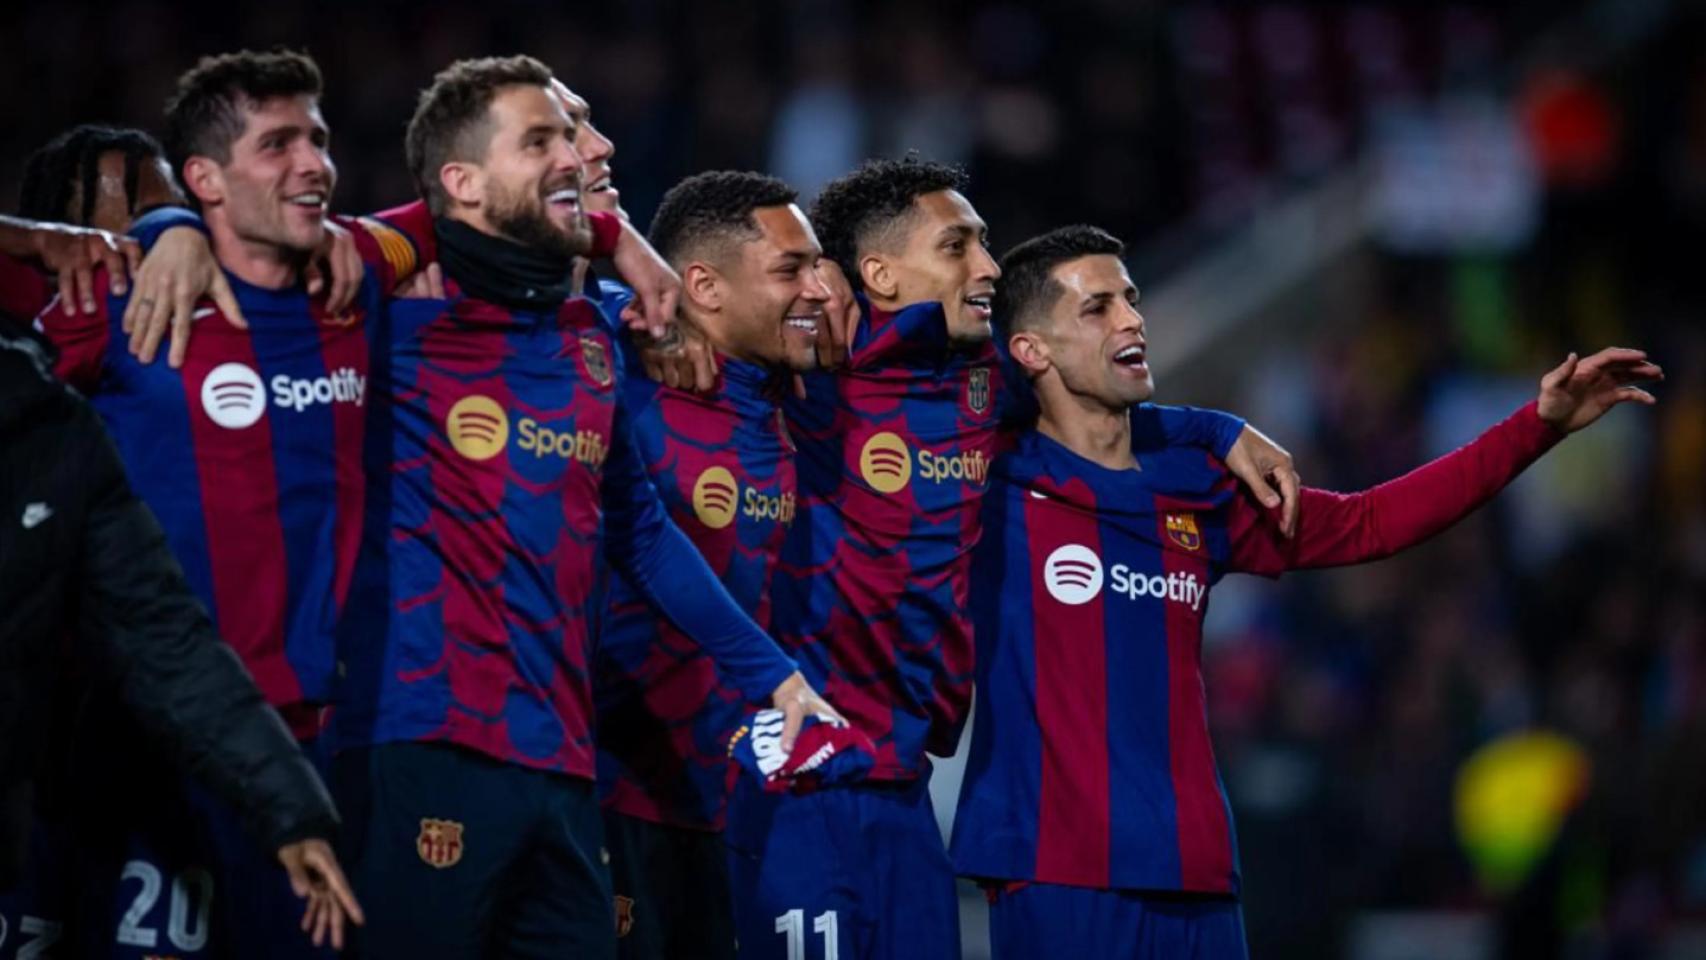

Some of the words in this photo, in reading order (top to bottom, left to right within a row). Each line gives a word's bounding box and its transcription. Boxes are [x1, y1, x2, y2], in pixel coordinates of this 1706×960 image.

[271, 366, 367, 413] Spotify
[918, 448, 991, 486] Spotify
[1109, 563, 1204, 611] Spotify
[116, 859, 214, 952] 20
[775, 908, 838, 960] 11
